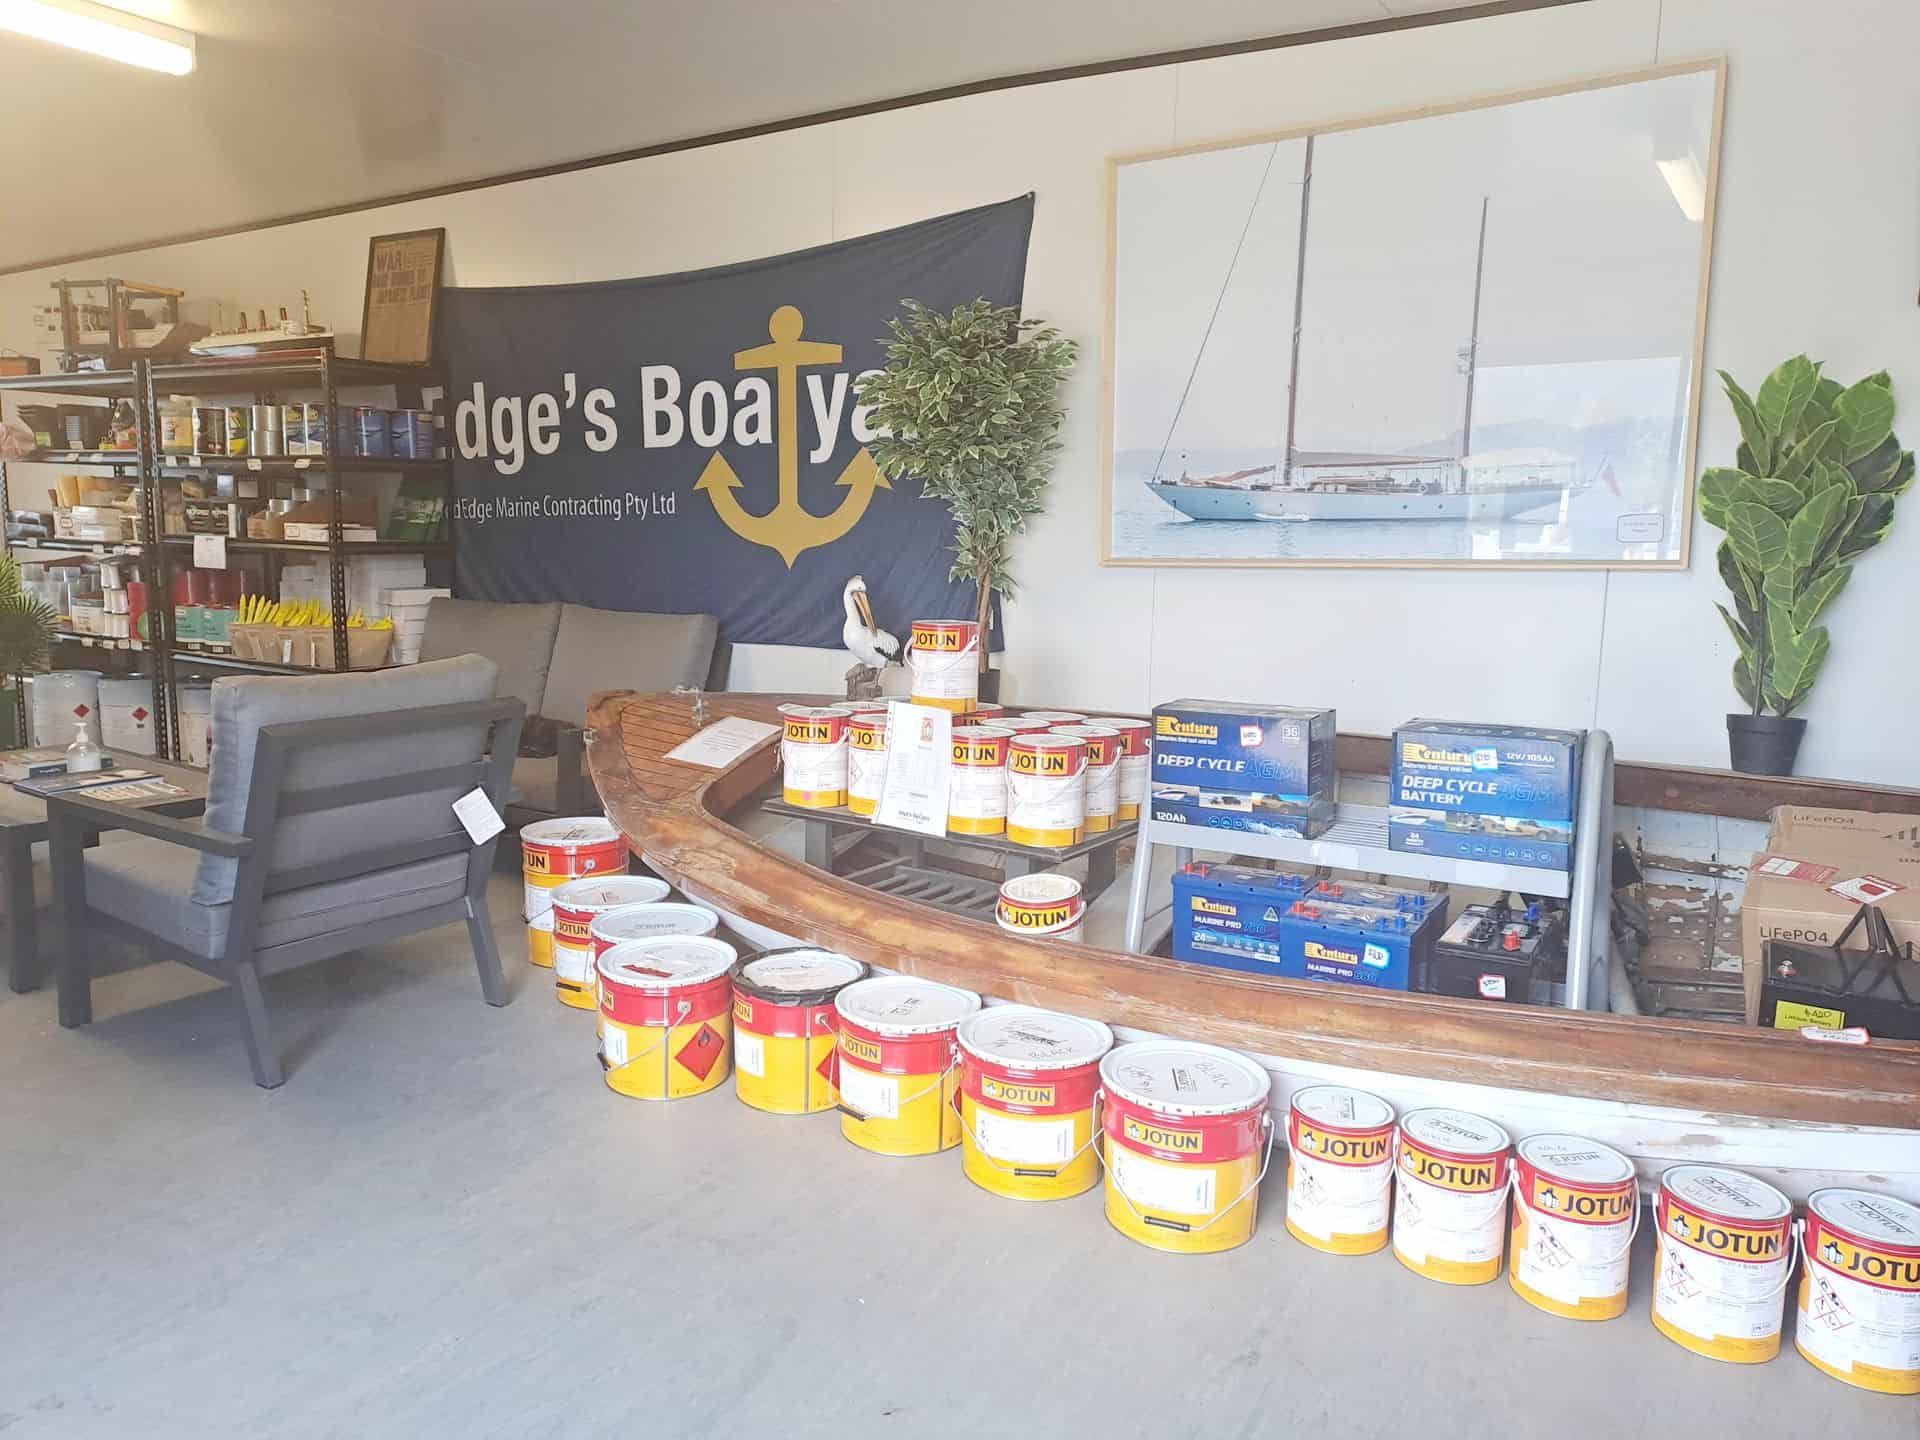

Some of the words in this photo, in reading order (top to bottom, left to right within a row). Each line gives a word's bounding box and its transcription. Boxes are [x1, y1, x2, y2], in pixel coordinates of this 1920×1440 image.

[496, 495, 540, 518] Marine
[543, 494, 622, 521] Contracting
[625, 492, 648, 520] Pty
[652, 491, 676, 515] Ltd
[786, 724, 828, 739] JOTUN
[1156, 715, 1218, 738] Century
[952, 745, 996, 761] OTUN
[1403, 743, 1473, 766] Century
[1015, 756, 1064, 771] JOTUN
[1157, 754, 1194, 767] DEEP
[1197, 757, 1246, 773] CYCLE
[1402, 775, 1443, 790] DEEP
[1446, 780, 1498, 795] CYCLE
[1401, 789, 1464, 805] BATTERY
[1156, 811, 1187, 824] 120Ah
[1013, 910, 1067, 927] JOTUN
[1194, 915, 1224, 927] MARINE
[1225, 919, 1242, 929] PRO
[1305, 942, 1358, 965] Century
[1337, 967, 1353, 977] PRO
[999, 1084, 1051, 1102] JOTUN
[1142, 1129, 1199, 1149] JOTUN
[1319, 1137, 1388, 1159] JOTUN
[1418, 1157, 1492, 1186] JOTUN
[1562, 1194, 1632, 1217] JOTUN
[1694, 1225, 1780, 1256] JOTUN
[1847, 1251, 1920, 1283] JOTU
